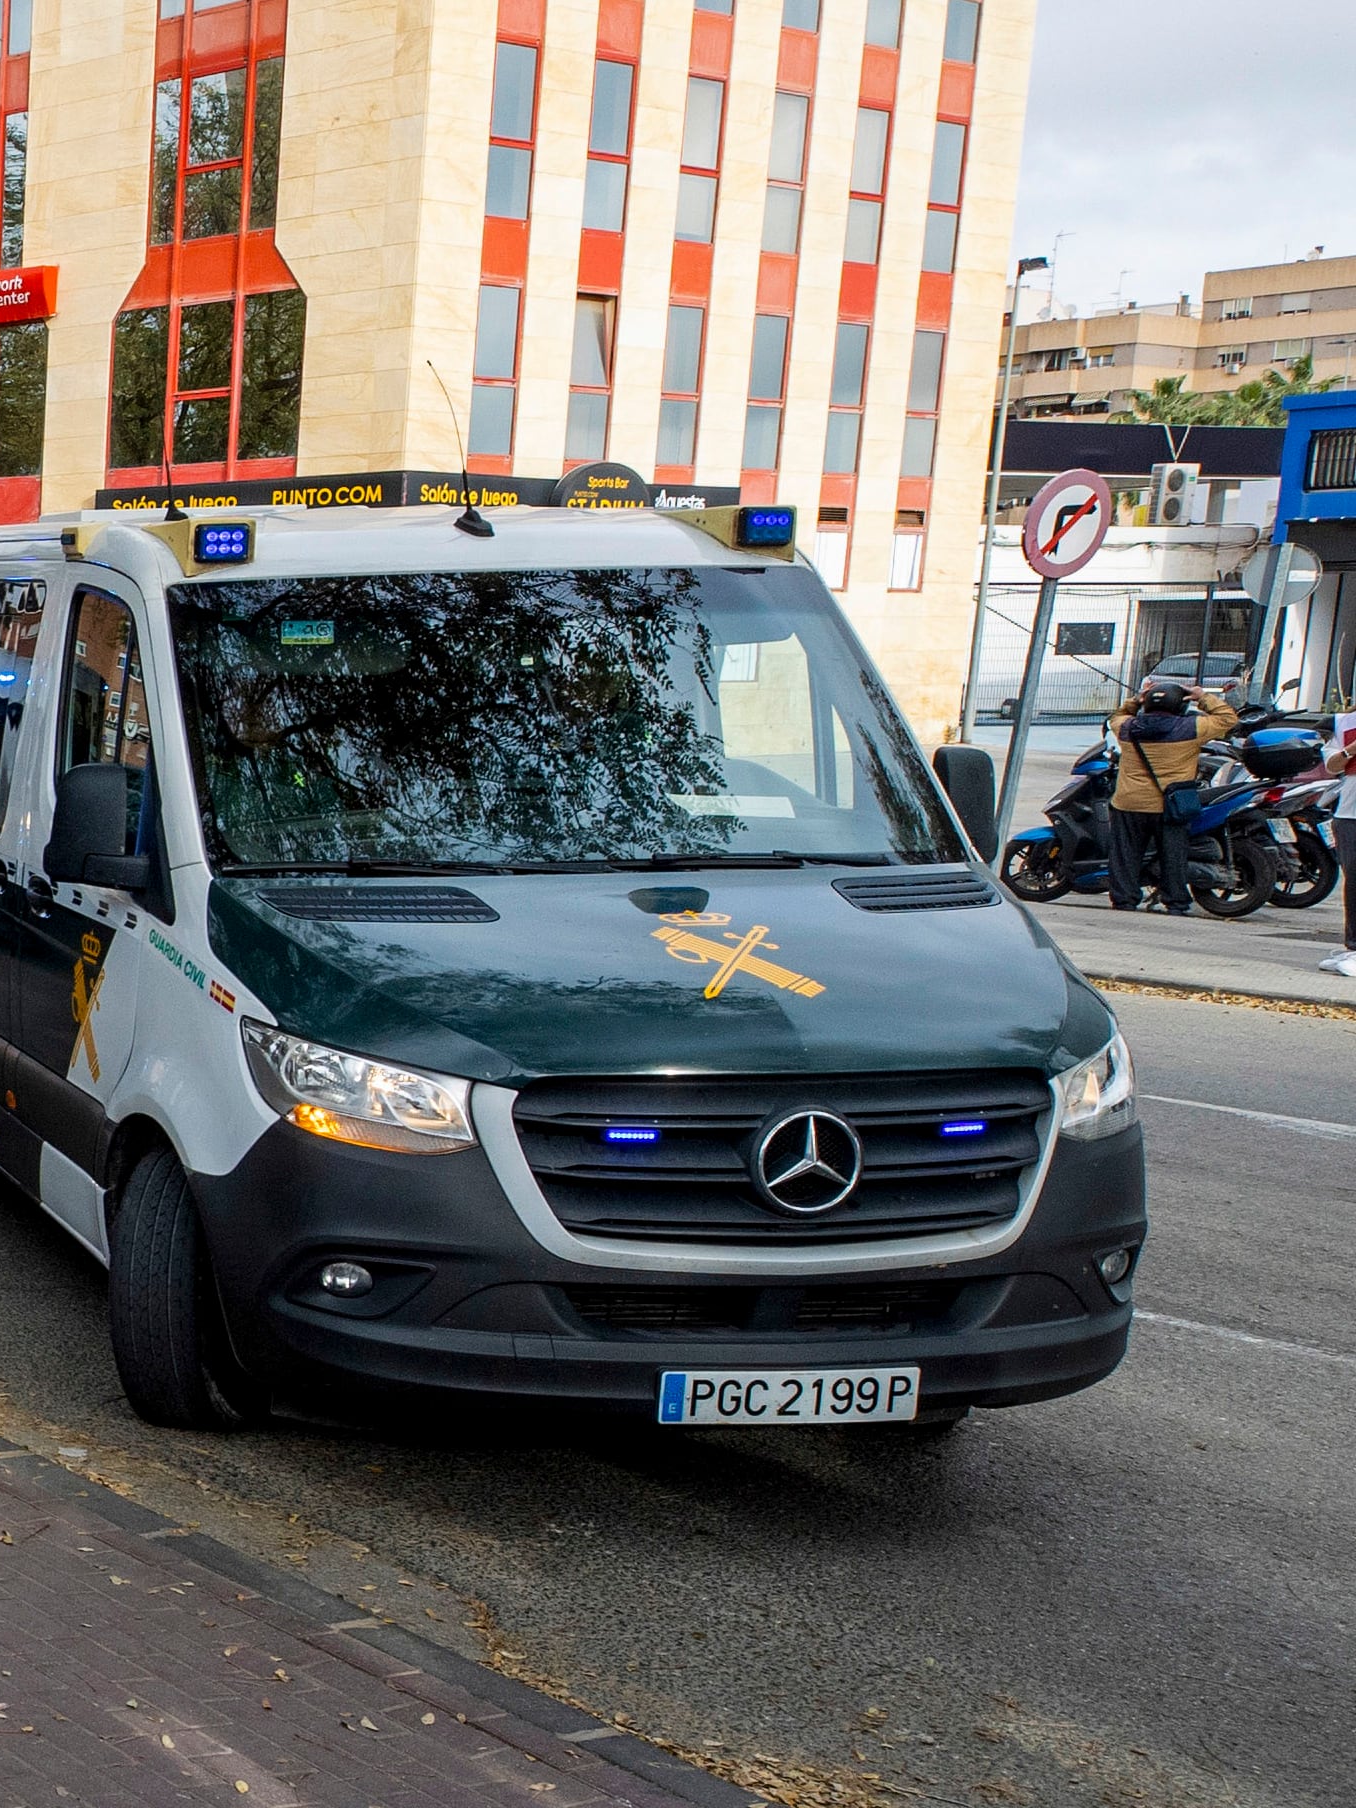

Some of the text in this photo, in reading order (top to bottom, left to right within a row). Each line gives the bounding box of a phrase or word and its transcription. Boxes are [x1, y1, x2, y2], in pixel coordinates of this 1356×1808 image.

[420, 482, 457, 503] Salón
[588, 476, 630, 489] Sports Bar
[272, 484, 383, 506] PUNTO COM
[148, 928, 206, 990] GUARDIA CIVIL
[689, 1375, 912, 1417] PGC 2199 P
